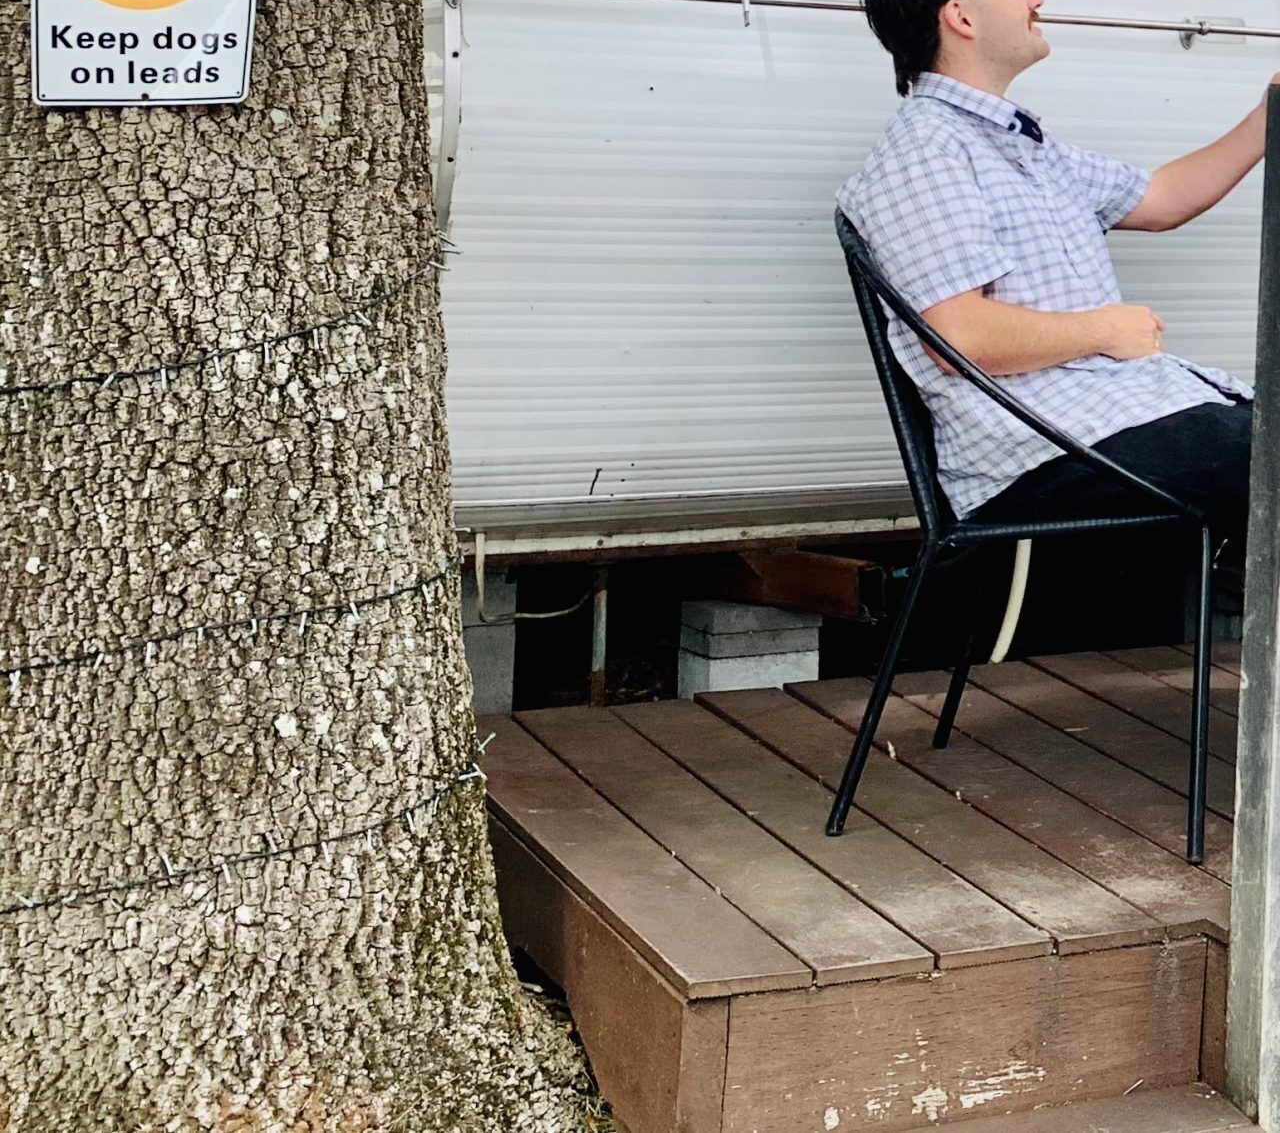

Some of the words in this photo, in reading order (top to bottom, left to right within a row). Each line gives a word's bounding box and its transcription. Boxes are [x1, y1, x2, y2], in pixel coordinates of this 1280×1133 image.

[50, 25, 139, 55] Keep
[152, 26, 238, 55] dogs
[70, 67, 115, 85] on
[127, 60, 220, 84] leads
